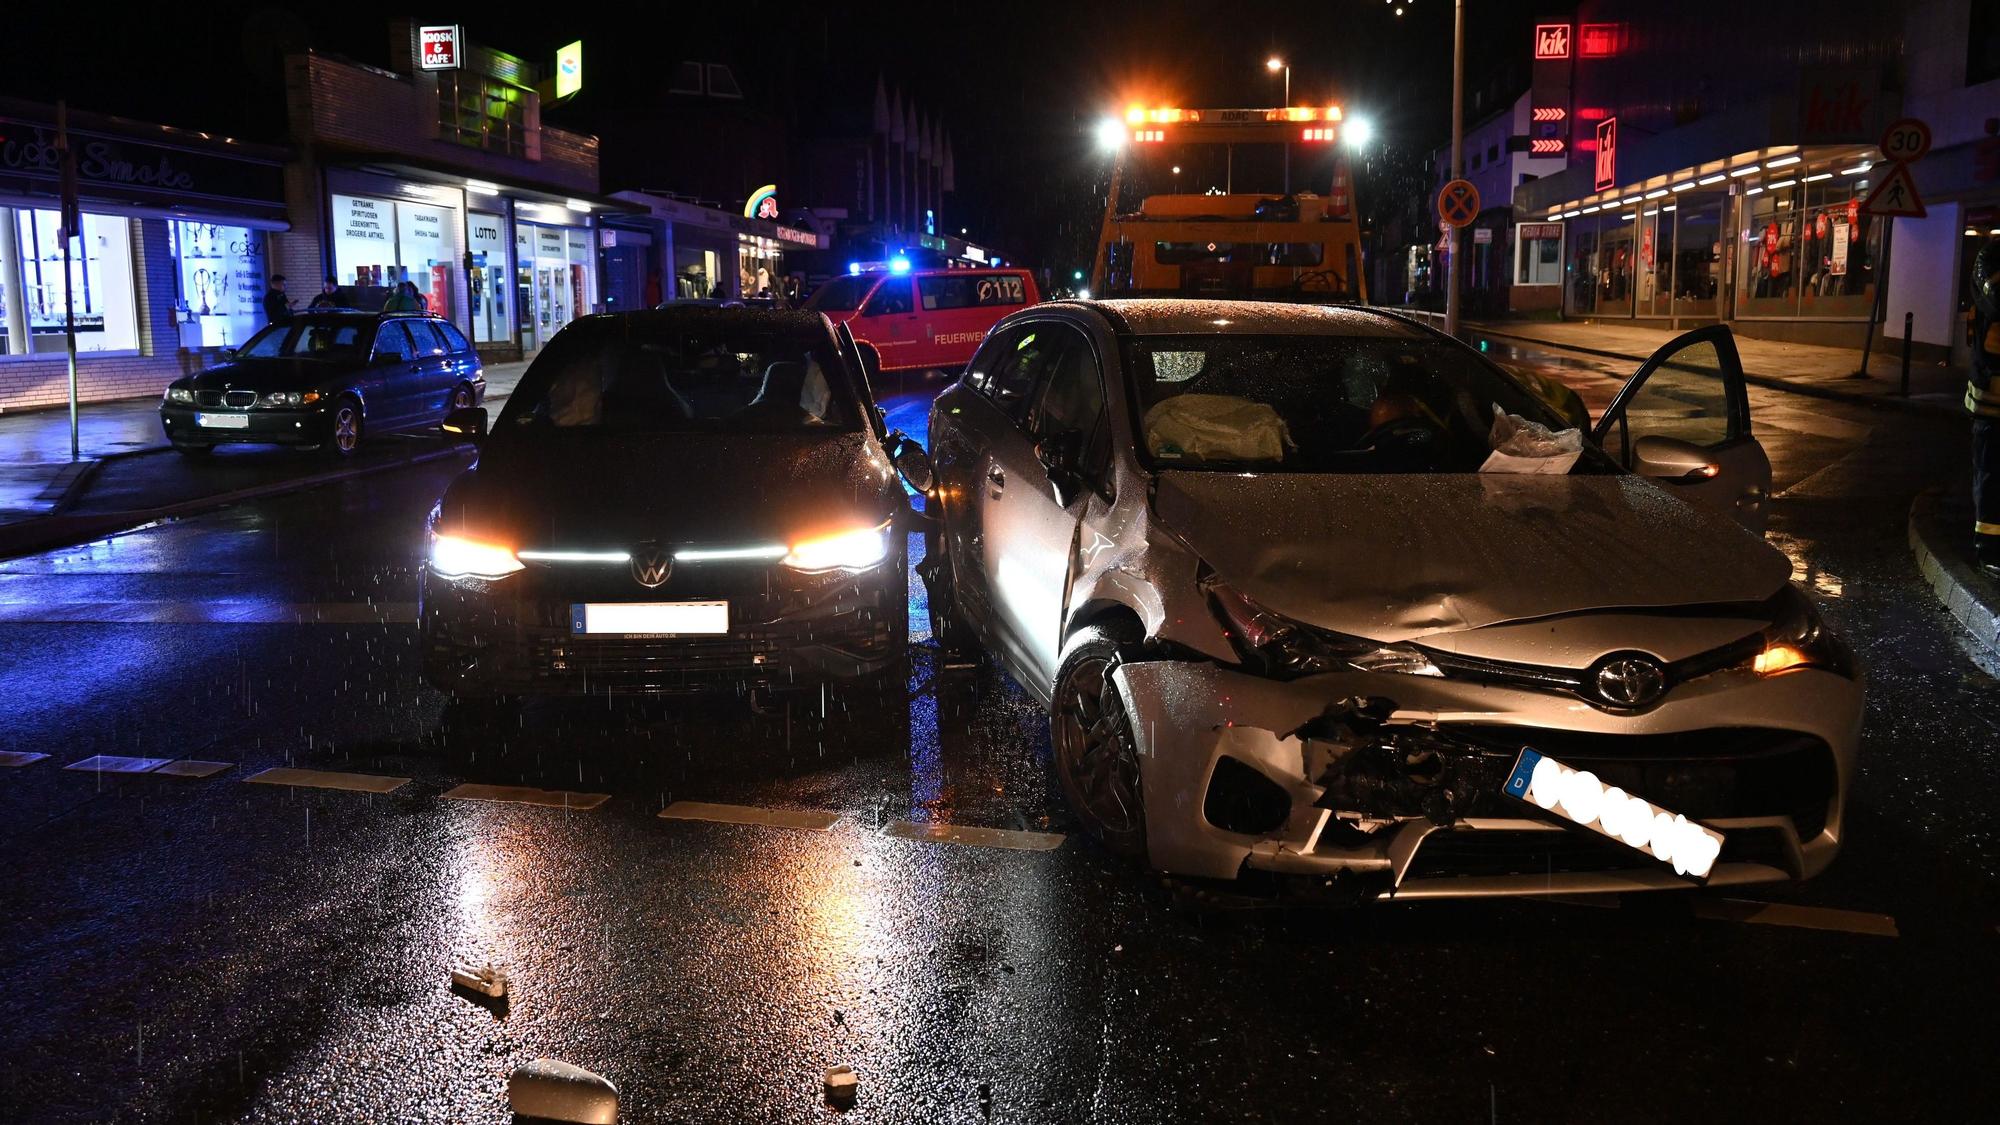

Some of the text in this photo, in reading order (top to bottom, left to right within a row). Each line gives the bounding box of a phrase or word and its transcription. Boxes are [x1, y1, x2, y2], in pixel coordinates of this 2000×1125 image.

[424, 32, 455, 42] KIOSK
[1539, 28, 1567, 55] kik
[434, 43, 443, 53] &
[1221, 111, 1249, 121] ADAC
[1890, 131, 1920, 151] 30
[81, 141, 195, 189] Smoke
[475, 226, 497, 240] LOTTO
[994, 280, 1022, 299] 112
[934, 331, 987, 346] FEUERWEH
[1514, 777, 1524, 788] D
